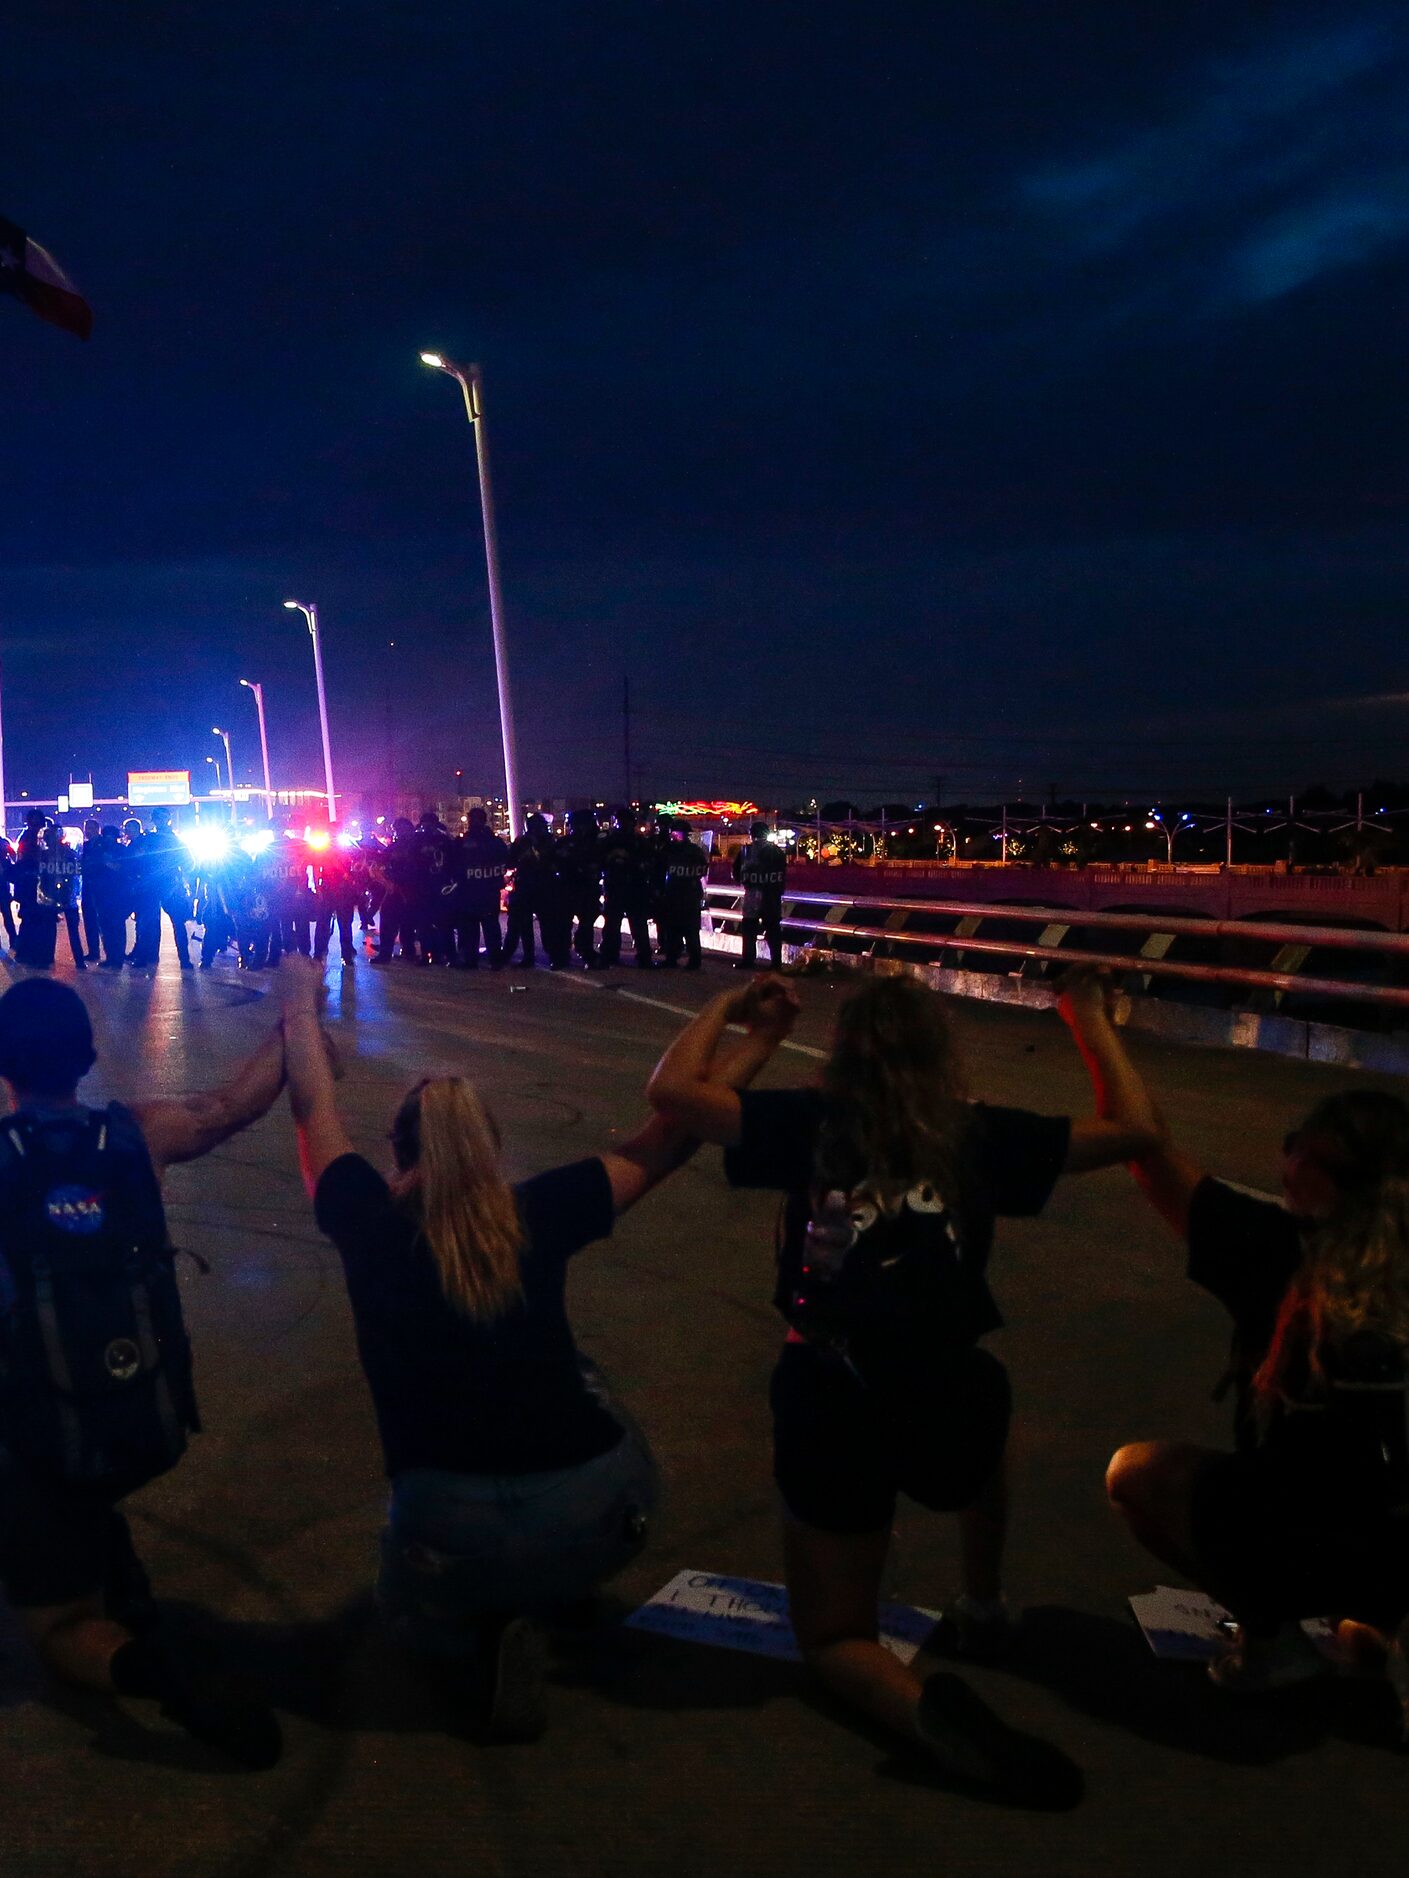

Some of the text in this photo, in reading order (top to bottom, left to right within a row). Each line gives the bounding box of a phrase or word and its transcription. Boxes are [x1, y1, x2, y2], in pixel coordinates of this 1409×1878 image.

[39, 862, 82, 875] POLICE
[466, 863, 507, 880] POLICE
[742, 870, 784, 883] POLICE
[48, 1201, 102, 1215] NASA
